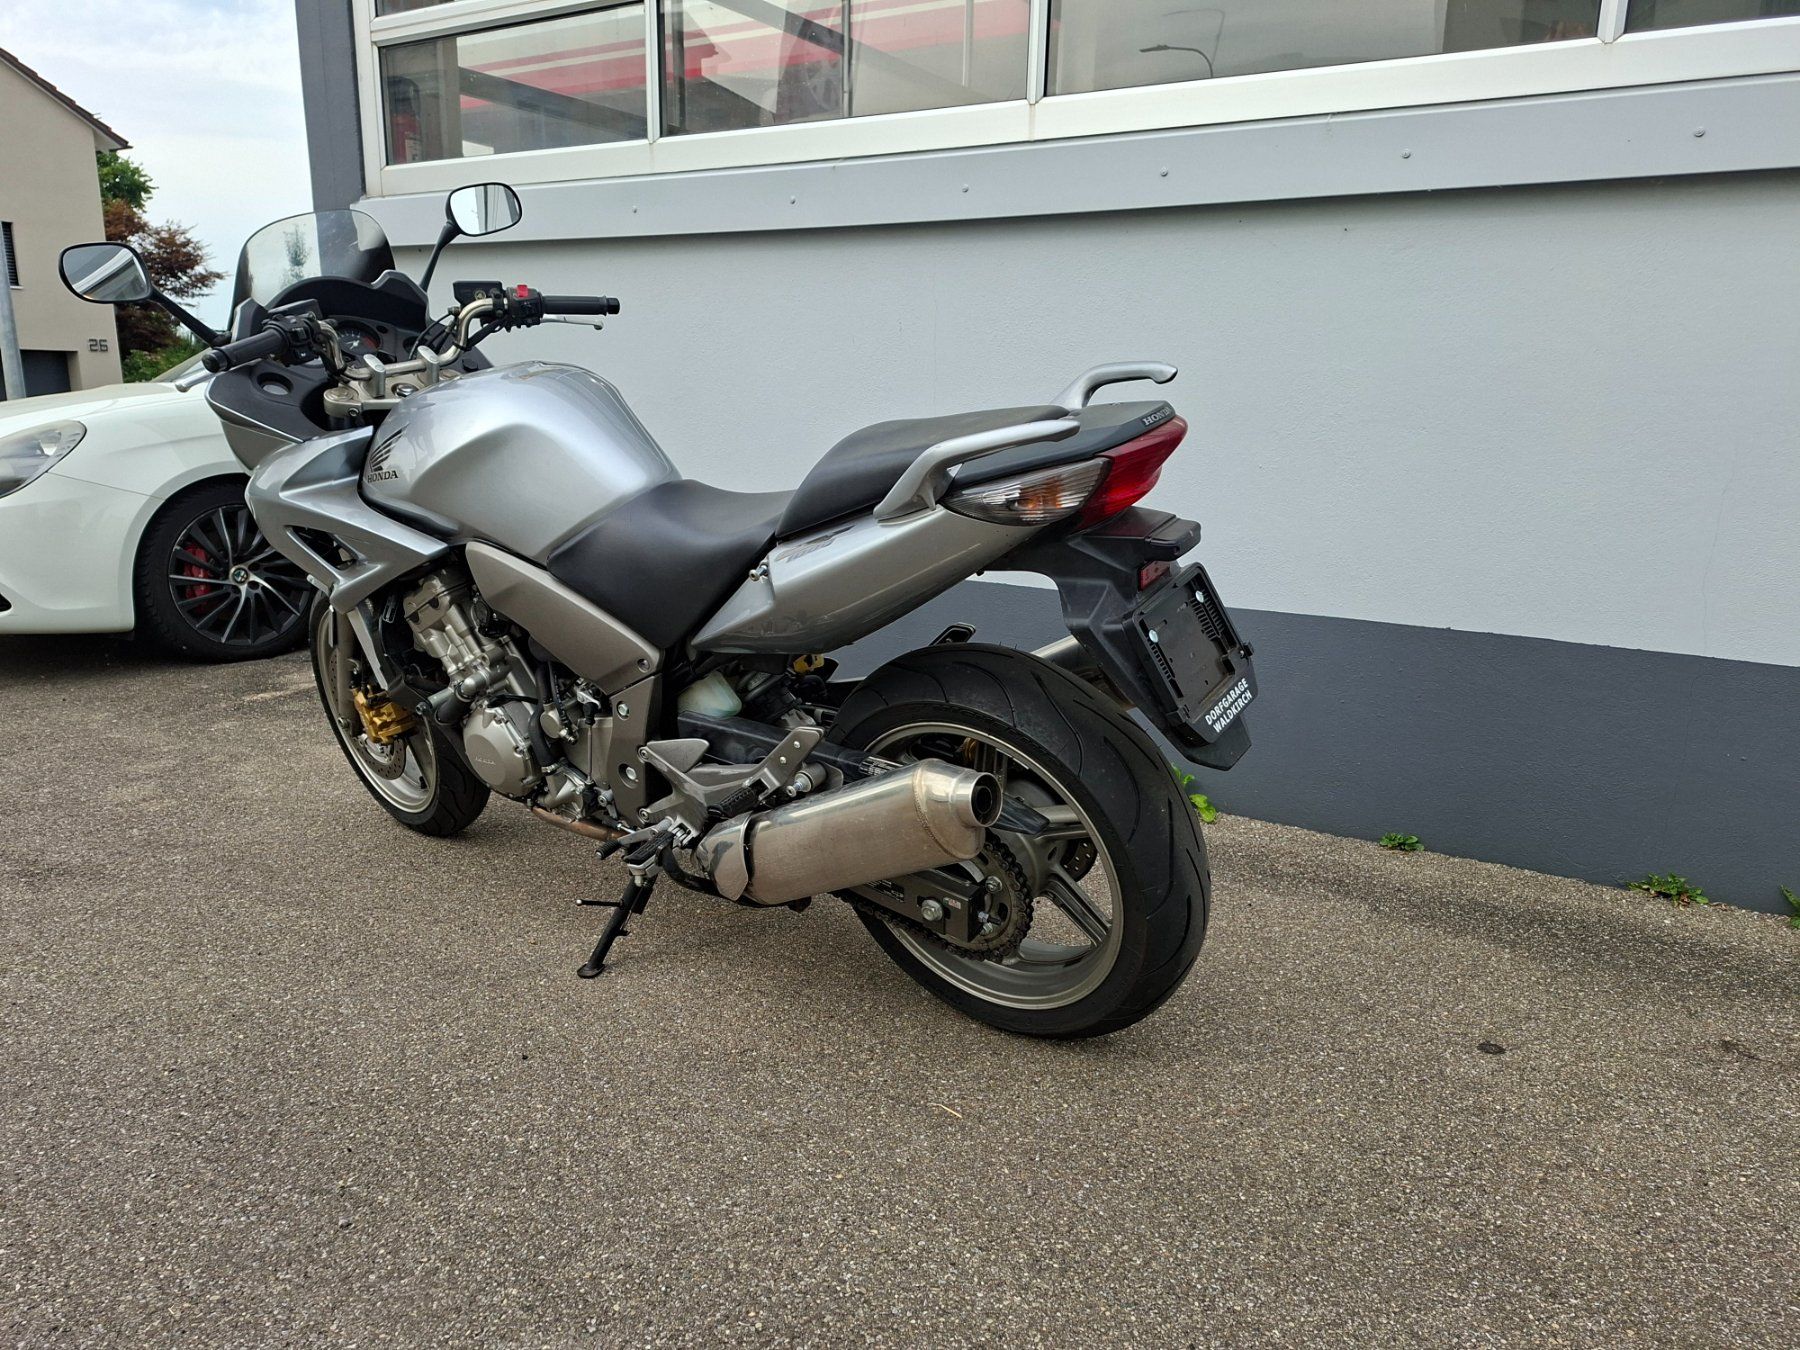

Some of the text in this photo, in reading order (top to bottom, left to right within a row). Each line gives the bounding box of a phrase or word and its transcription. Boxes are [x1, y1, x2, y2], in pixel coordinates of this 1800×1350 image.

[89, 338, 108, 352] 26
[1142, 406, 1171, 426] HOND
[367, 470, 399, 483] HONDA
[1205, 678, 1249, 725] DORFGARAGE
[1213, 690, 1253, 733] WALDKIRCH
